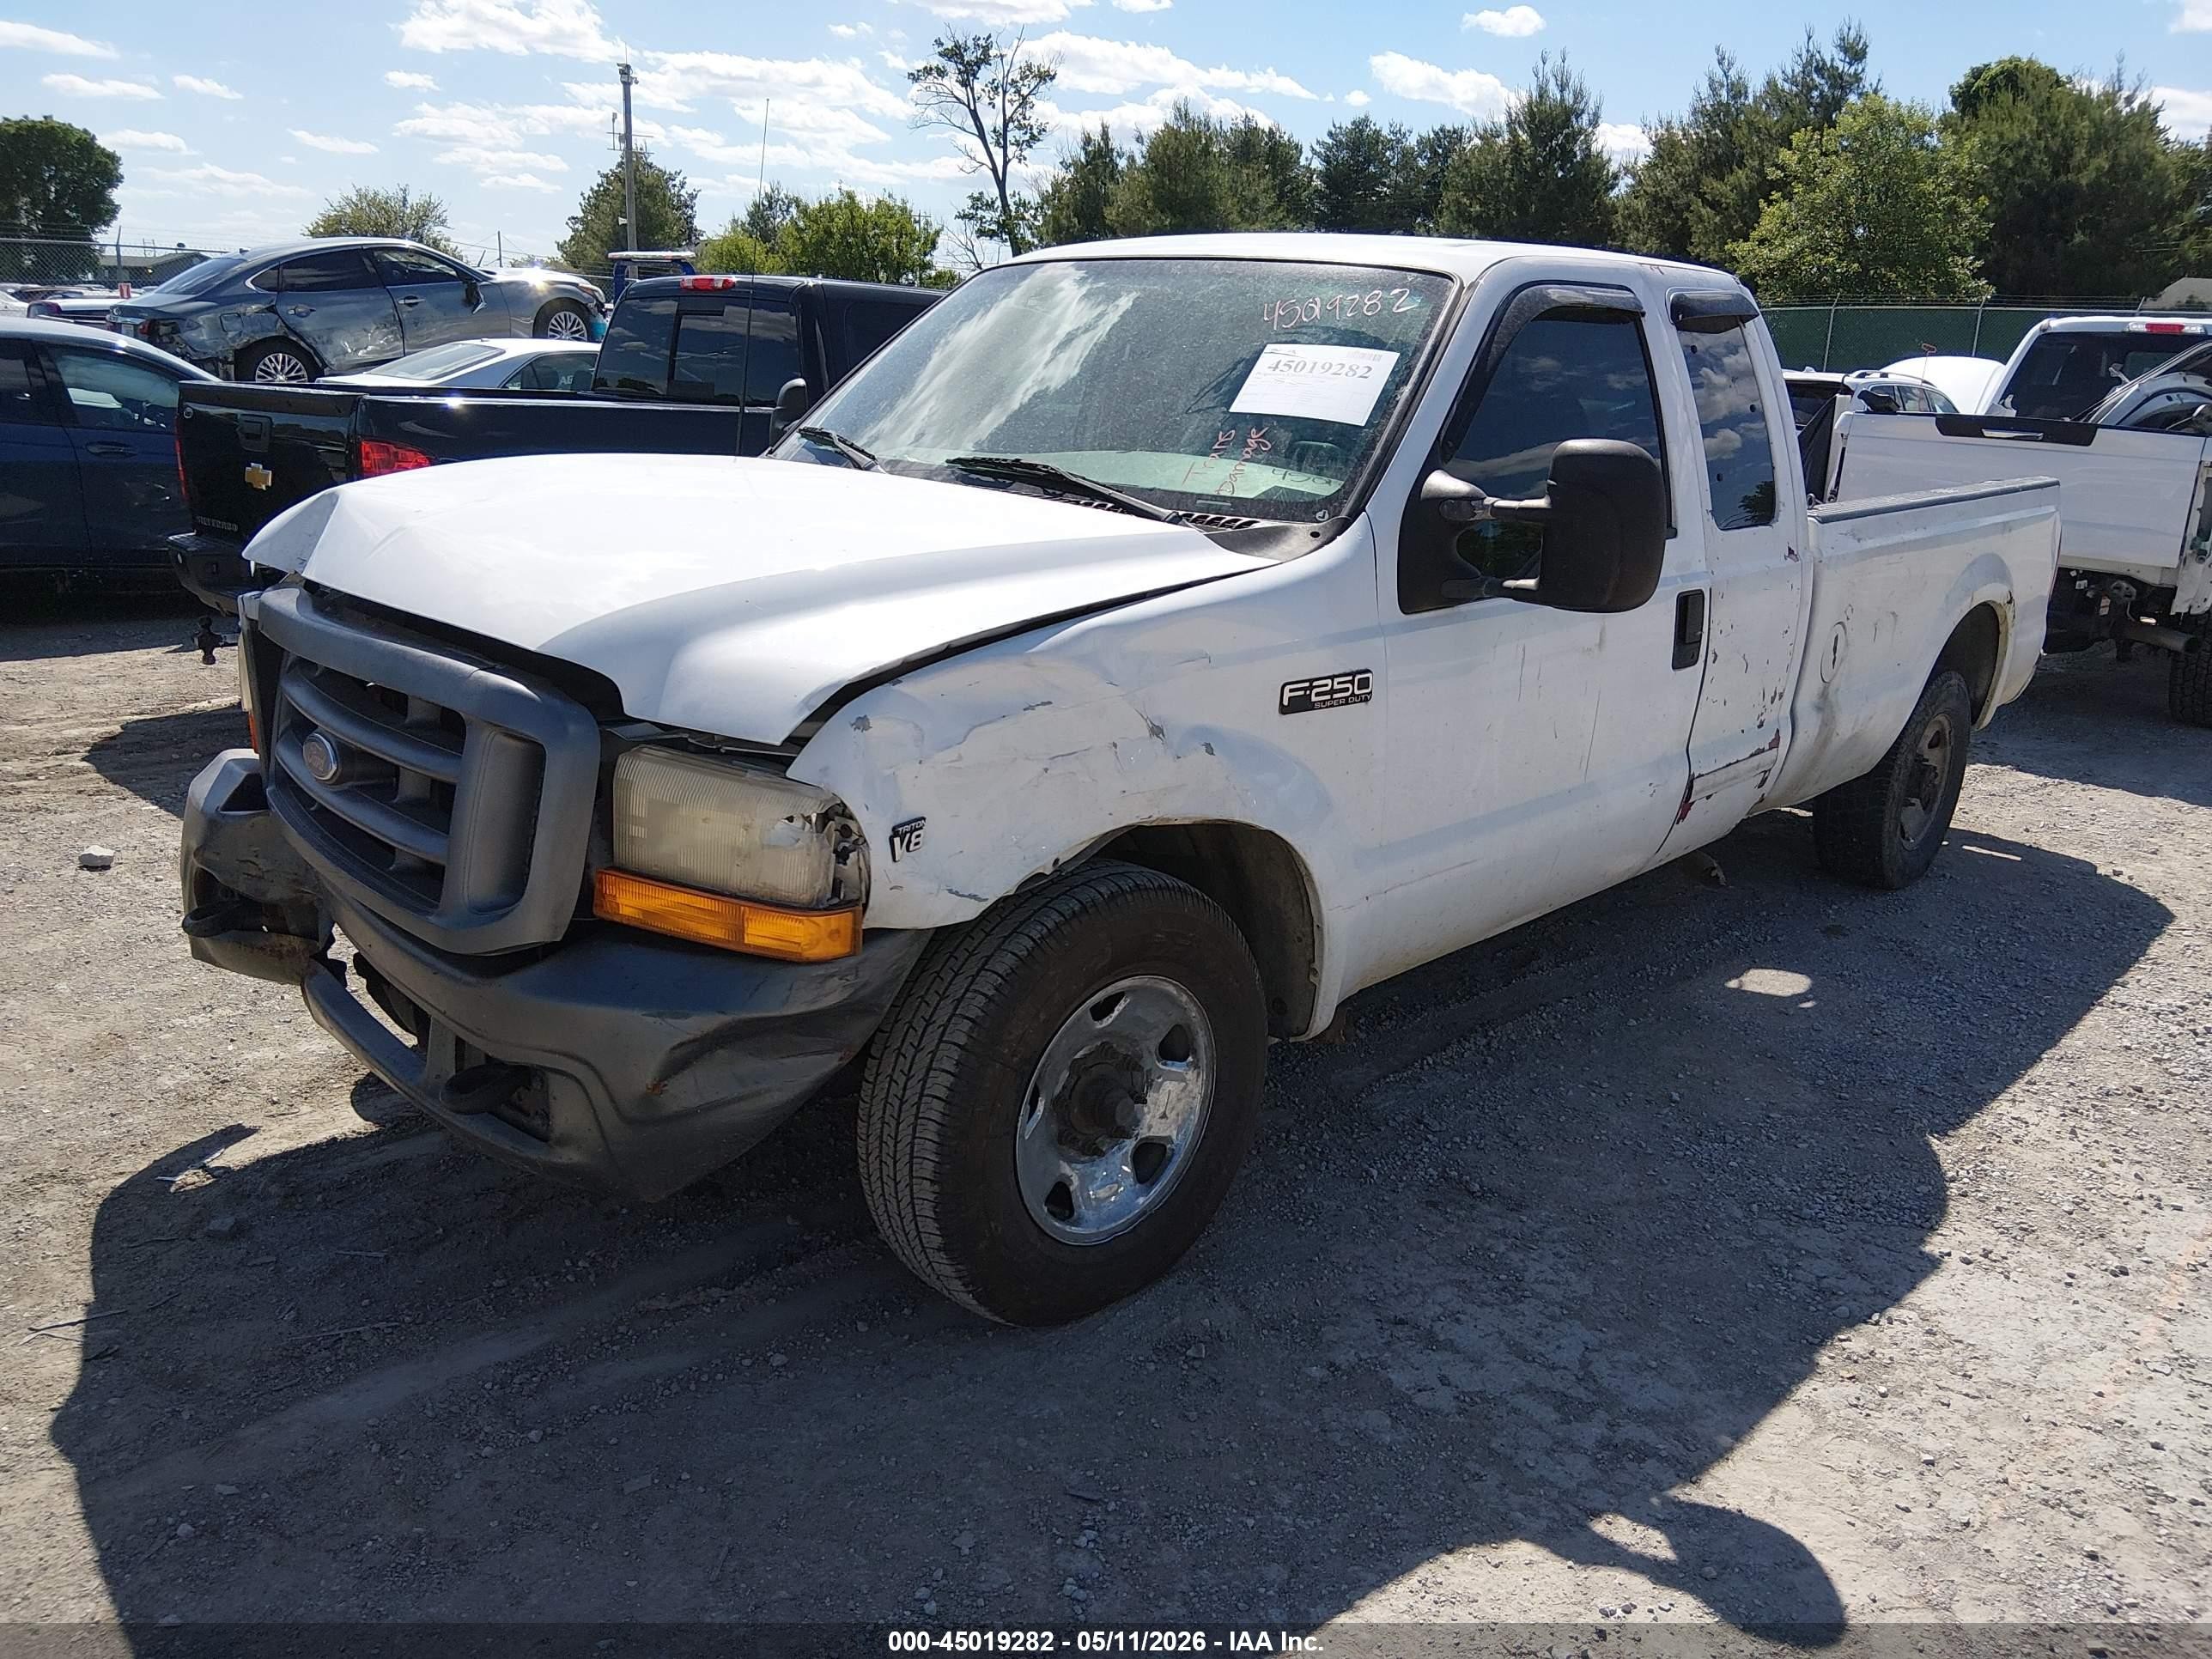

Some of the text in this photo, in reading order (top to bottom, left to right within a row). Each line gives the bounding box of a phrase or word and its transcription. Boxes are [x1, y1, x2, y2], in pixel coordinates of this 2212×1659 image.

[1268, 359, 1373, 379] 45019282
[1216, 426, 1270, 495] Damage
[1282, 672, 1373, 706] F-250
[1314, 694, 1371, 708] SUPER DUTY
[897, 819, 926, 834] TRITON
[892, 830, 924, 861] V8
